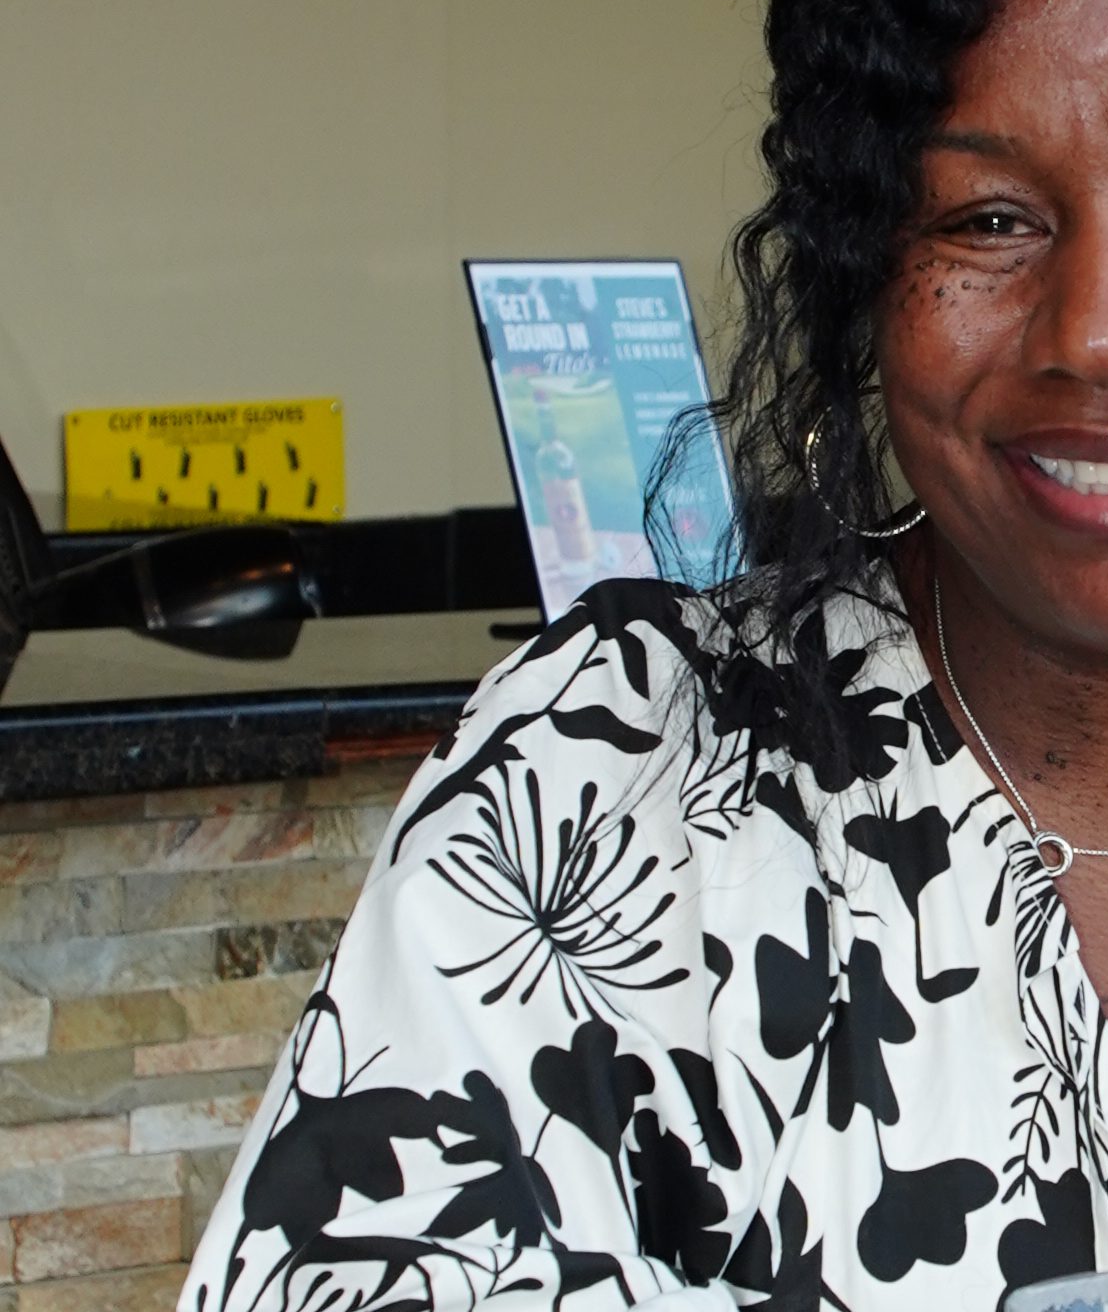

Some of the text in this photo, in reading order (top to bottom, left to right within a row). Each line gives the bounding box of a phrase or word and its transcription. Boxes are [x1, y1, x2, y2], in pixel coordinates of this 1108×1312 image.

[498, 294, 531, 321] GET
[503, 322, 590, 351] ROUND IN
[108, 405, 305, 432] CUT RESISTANT GLOVES
